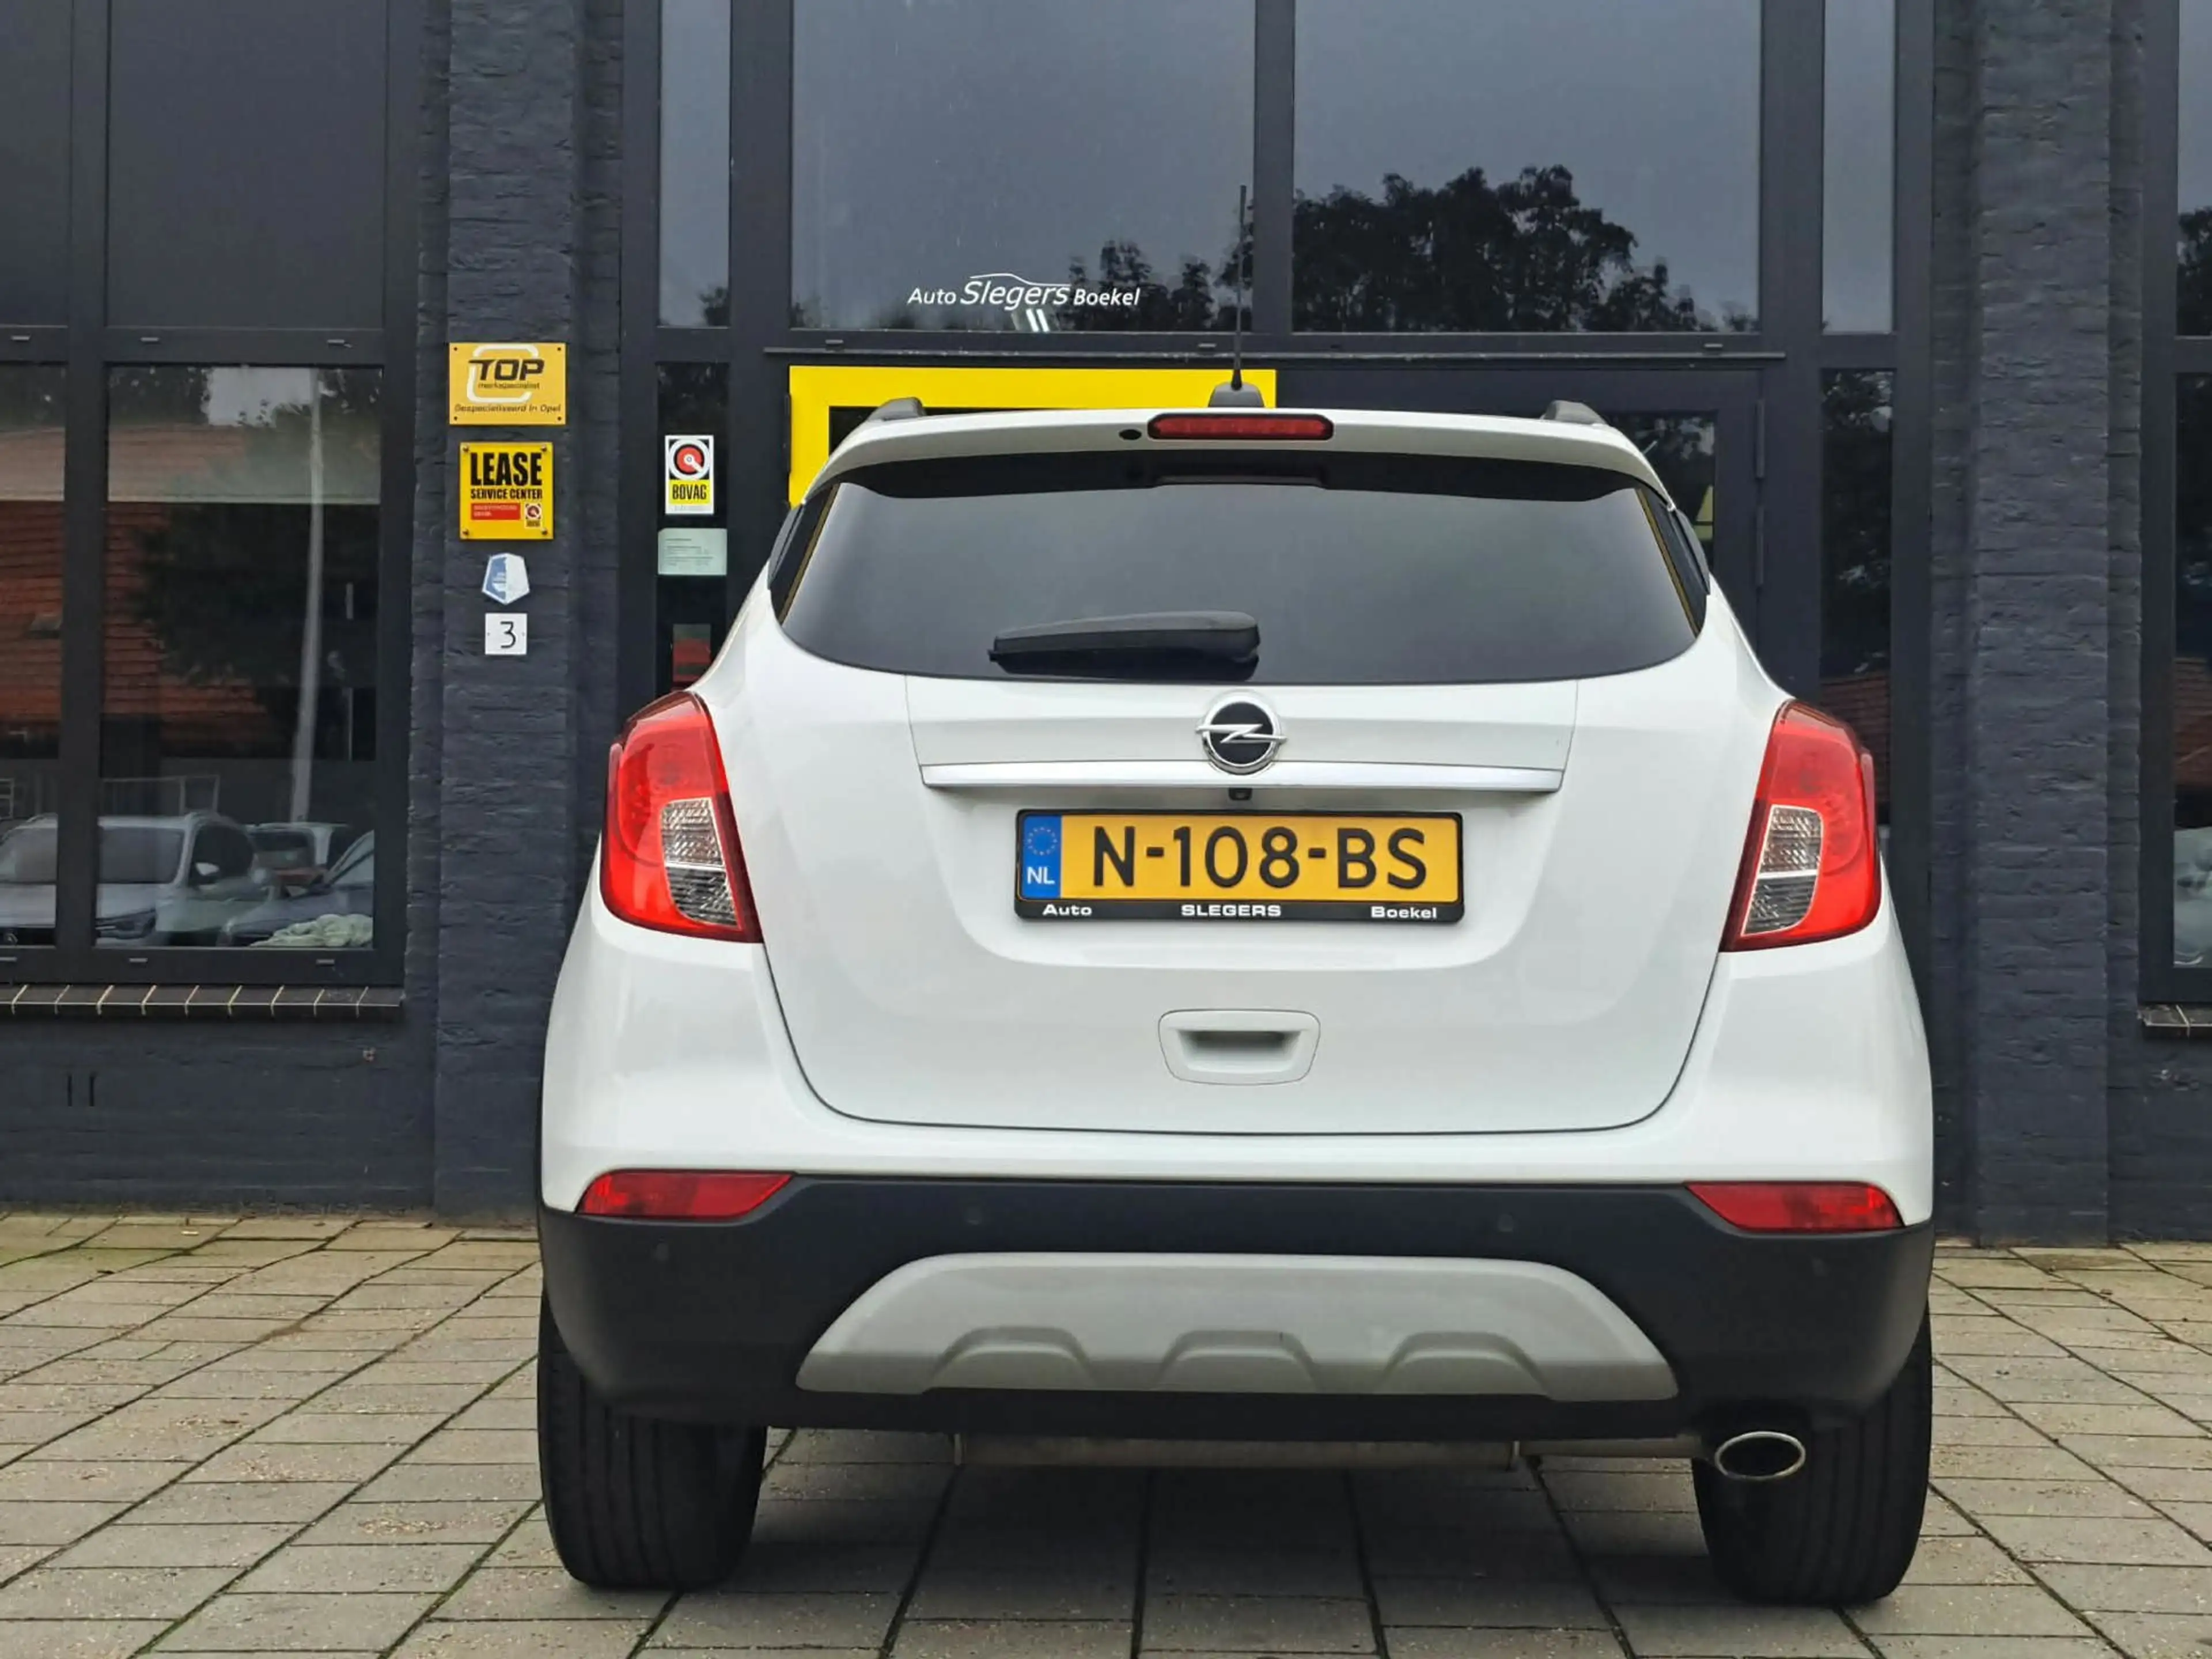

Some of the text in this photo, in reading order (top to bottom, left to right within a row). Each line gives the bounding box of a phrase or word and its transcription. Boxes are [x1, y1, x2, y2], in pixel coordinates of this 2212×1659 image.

[907, 281, 1141, 311] Auto Slegers Boekel
[468, 359, 544, 381] TOP
[470, 452, 543, 486] LEASE
[471, 488, 543, 499] SERVICE CENTER
[672, 484, 707, 500] BOVAG
[500, 621, 516, 649] 3
[1093, 825, 1427, 890] N-108-BS
[1027, 866, 1055, 885] NL
[1042, 904, 1437, 919] Auto SLEGERS Boekel
